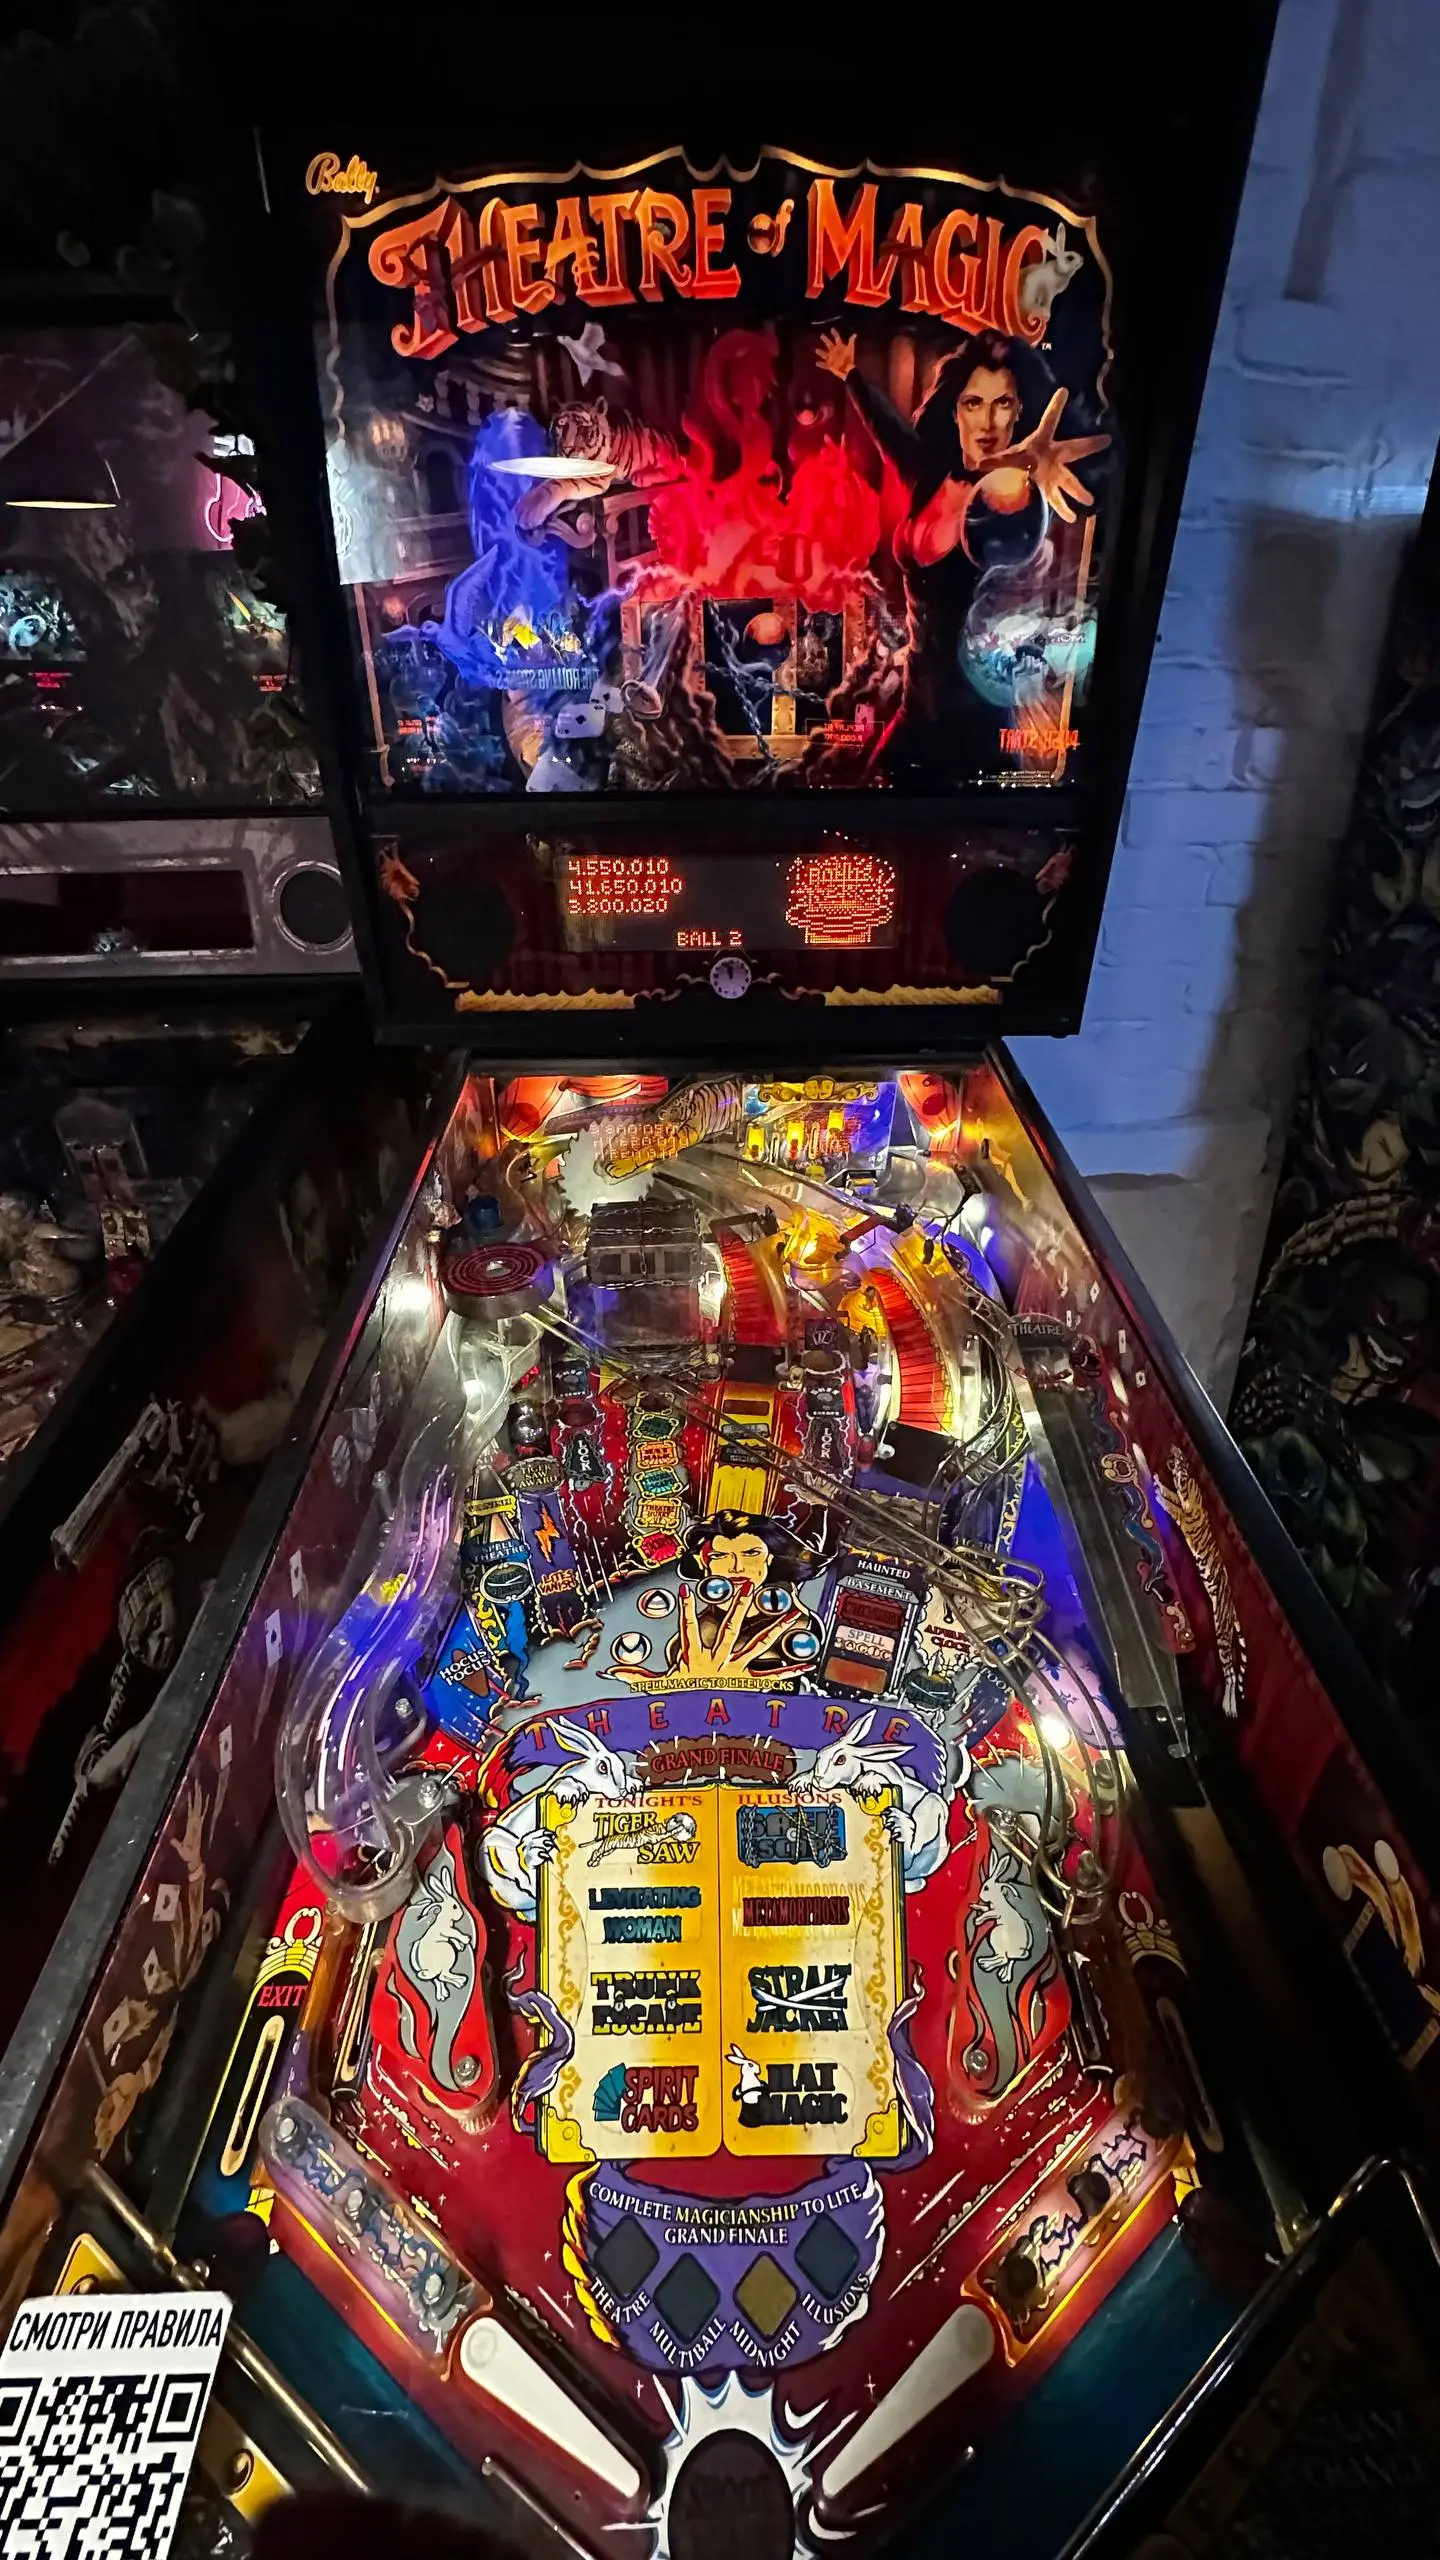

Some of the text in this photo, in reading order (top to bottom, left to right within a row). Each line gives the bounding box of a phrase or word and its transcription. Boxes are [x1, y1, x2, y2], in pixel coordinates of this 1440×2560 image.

[305, 152, 379, 203] Bally
[369, 179, 1052, 360] THEATRE of MAGIC
[677, 930, 744, 947] BALL 2
[578, 1440, 592, 1472] LOCK
[821, 1428, 831, 1459] LOCK
[519, 1476, 557, 1488] AWARD
[525, 1472, 547, 1481] SAW
[857, 1559, 911, 1580] HAUNTED
[847, 1577, 911, 1600] BASEMENT
[847, 1628, 885, 1647] SPELL
[924, 1624, 970, 1641] ADVAN
[439, 1648, 488, 1679] HOCUS
[446, 1656, 491, 1686] POCUS
[630, 1677, 794, 1693] SPELL MAGIC TO LITE LOCKS
[652, 1750, 785, 1774] GRAND FINALE
[595, 1794, 703, 1809] TONIGHT'S
[738, 1793, 842, 1806] ILLUSIONS
[593, 1812, 656, 1842] TIGER
[637, 1842, 700, 1865] SAW
[743, 1896, 850, 1927] METAMORPHOSIS
[602, 1915, 682, 1944] WOMAN
[257, 1984, 308, 2007] EXIT
[591, 1971, 701, 2000] TRUNK
[592, 2003, 702, 2035] ESCAPE
[625, 2066, 699, 2105] SPIRIT
[766, 2063, 838, 2093] HAT
[621, 2104, 699, 2134] CARDS
[588, 2182, 863, 2224] COMPLETE MAGICIANSHIP TO LITE
[664, 2228, 788, 2245] GRAND FINALE
[591, 2276, 652, 2325] THEATRE
[802, 2274, 871, 2326] ILLUSIONS
[9, 2308, 225, 2350] СМОТРИ ПРАВИЛА
[648, 2317, 727, 2368] MULTIBALL
[729, 2321, 802, 2368] MIDNIGHT
